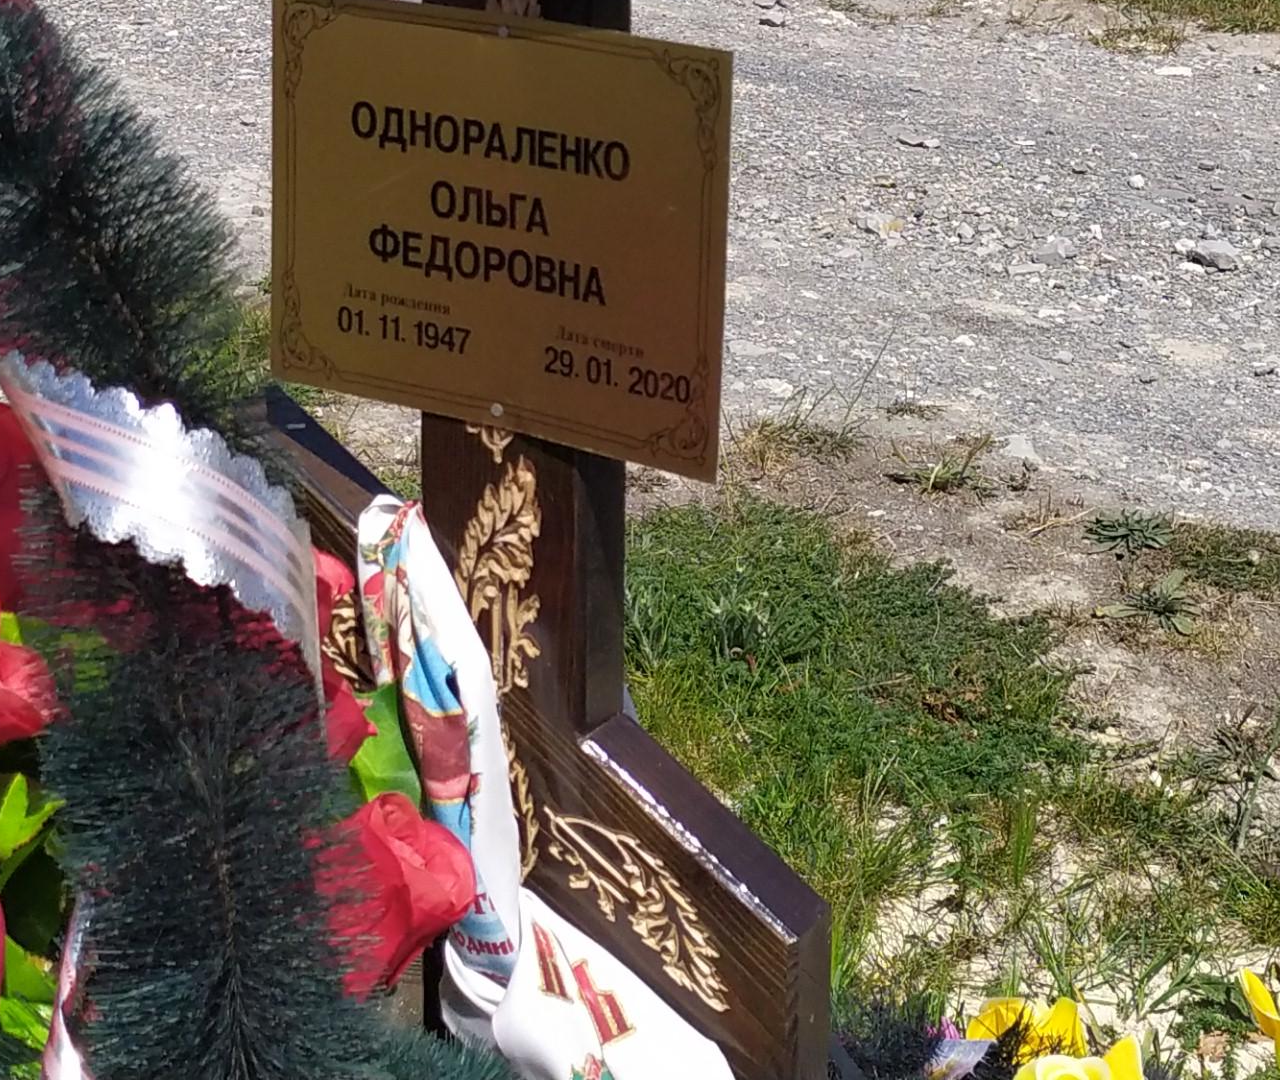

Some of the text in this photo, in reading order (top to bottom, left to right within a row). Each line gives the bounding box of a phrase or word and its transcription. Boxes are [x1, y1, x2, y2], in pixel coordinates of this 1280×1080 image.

[351, 100, 630, 181] ОДНОРАЛЕНКО
[431, 181, 550, 236] ОЛЬГА
[369, 224, 607, 306] ФЕДОРОВНА
[343, 282, 451, 316] Дата рождения
[555, 325, 645, 359] Дата смерти
